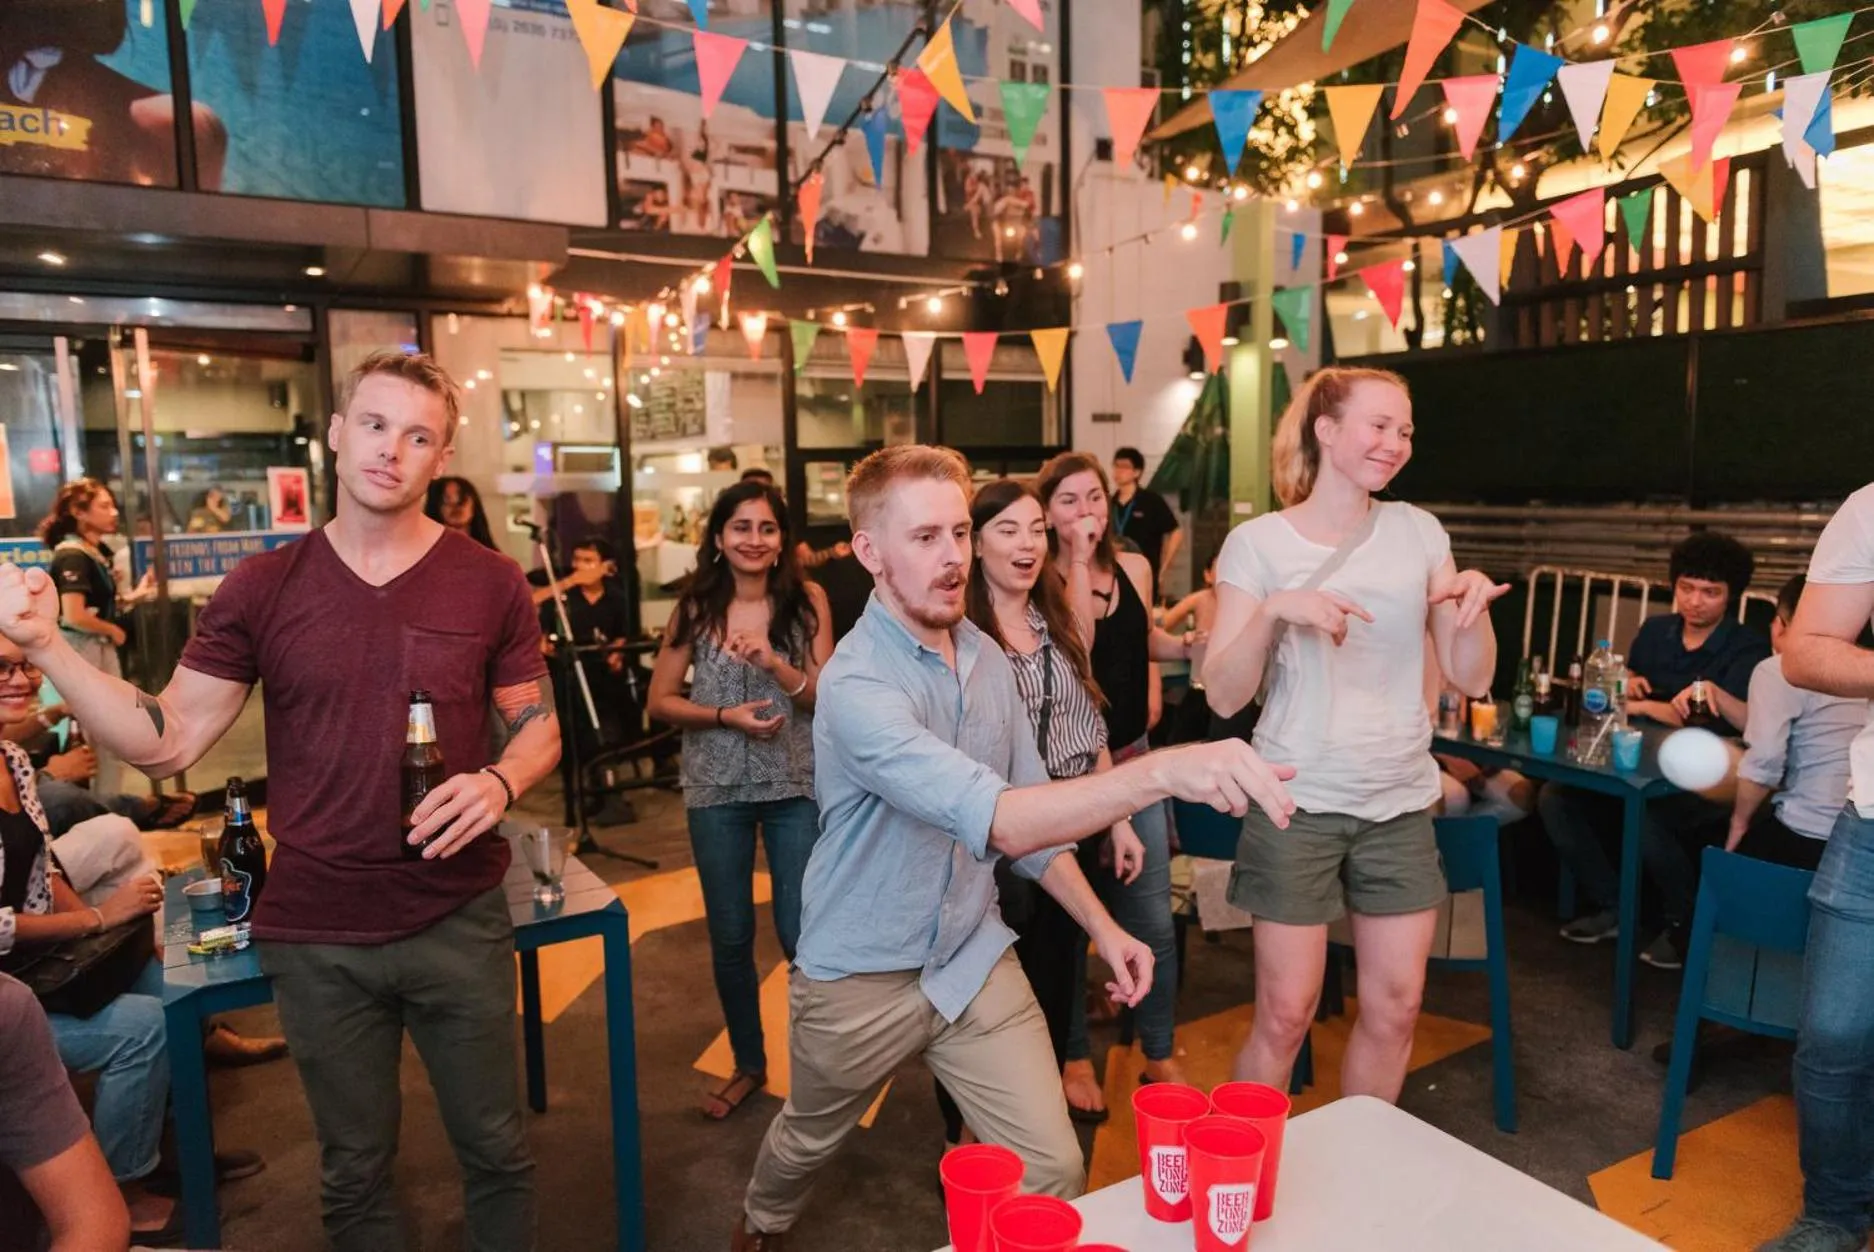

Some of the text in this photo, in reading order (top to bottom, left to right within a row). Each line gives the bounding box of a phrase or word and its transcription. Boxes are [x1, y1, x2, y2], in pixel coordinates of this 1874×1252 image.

[0, 101, 64, 137] ach
[1217, 1191, 1249, 1208] BEER
[1217, 1206, 1248, 1221] PONG
[1217, 1219, 1246, 1234] ZONE
